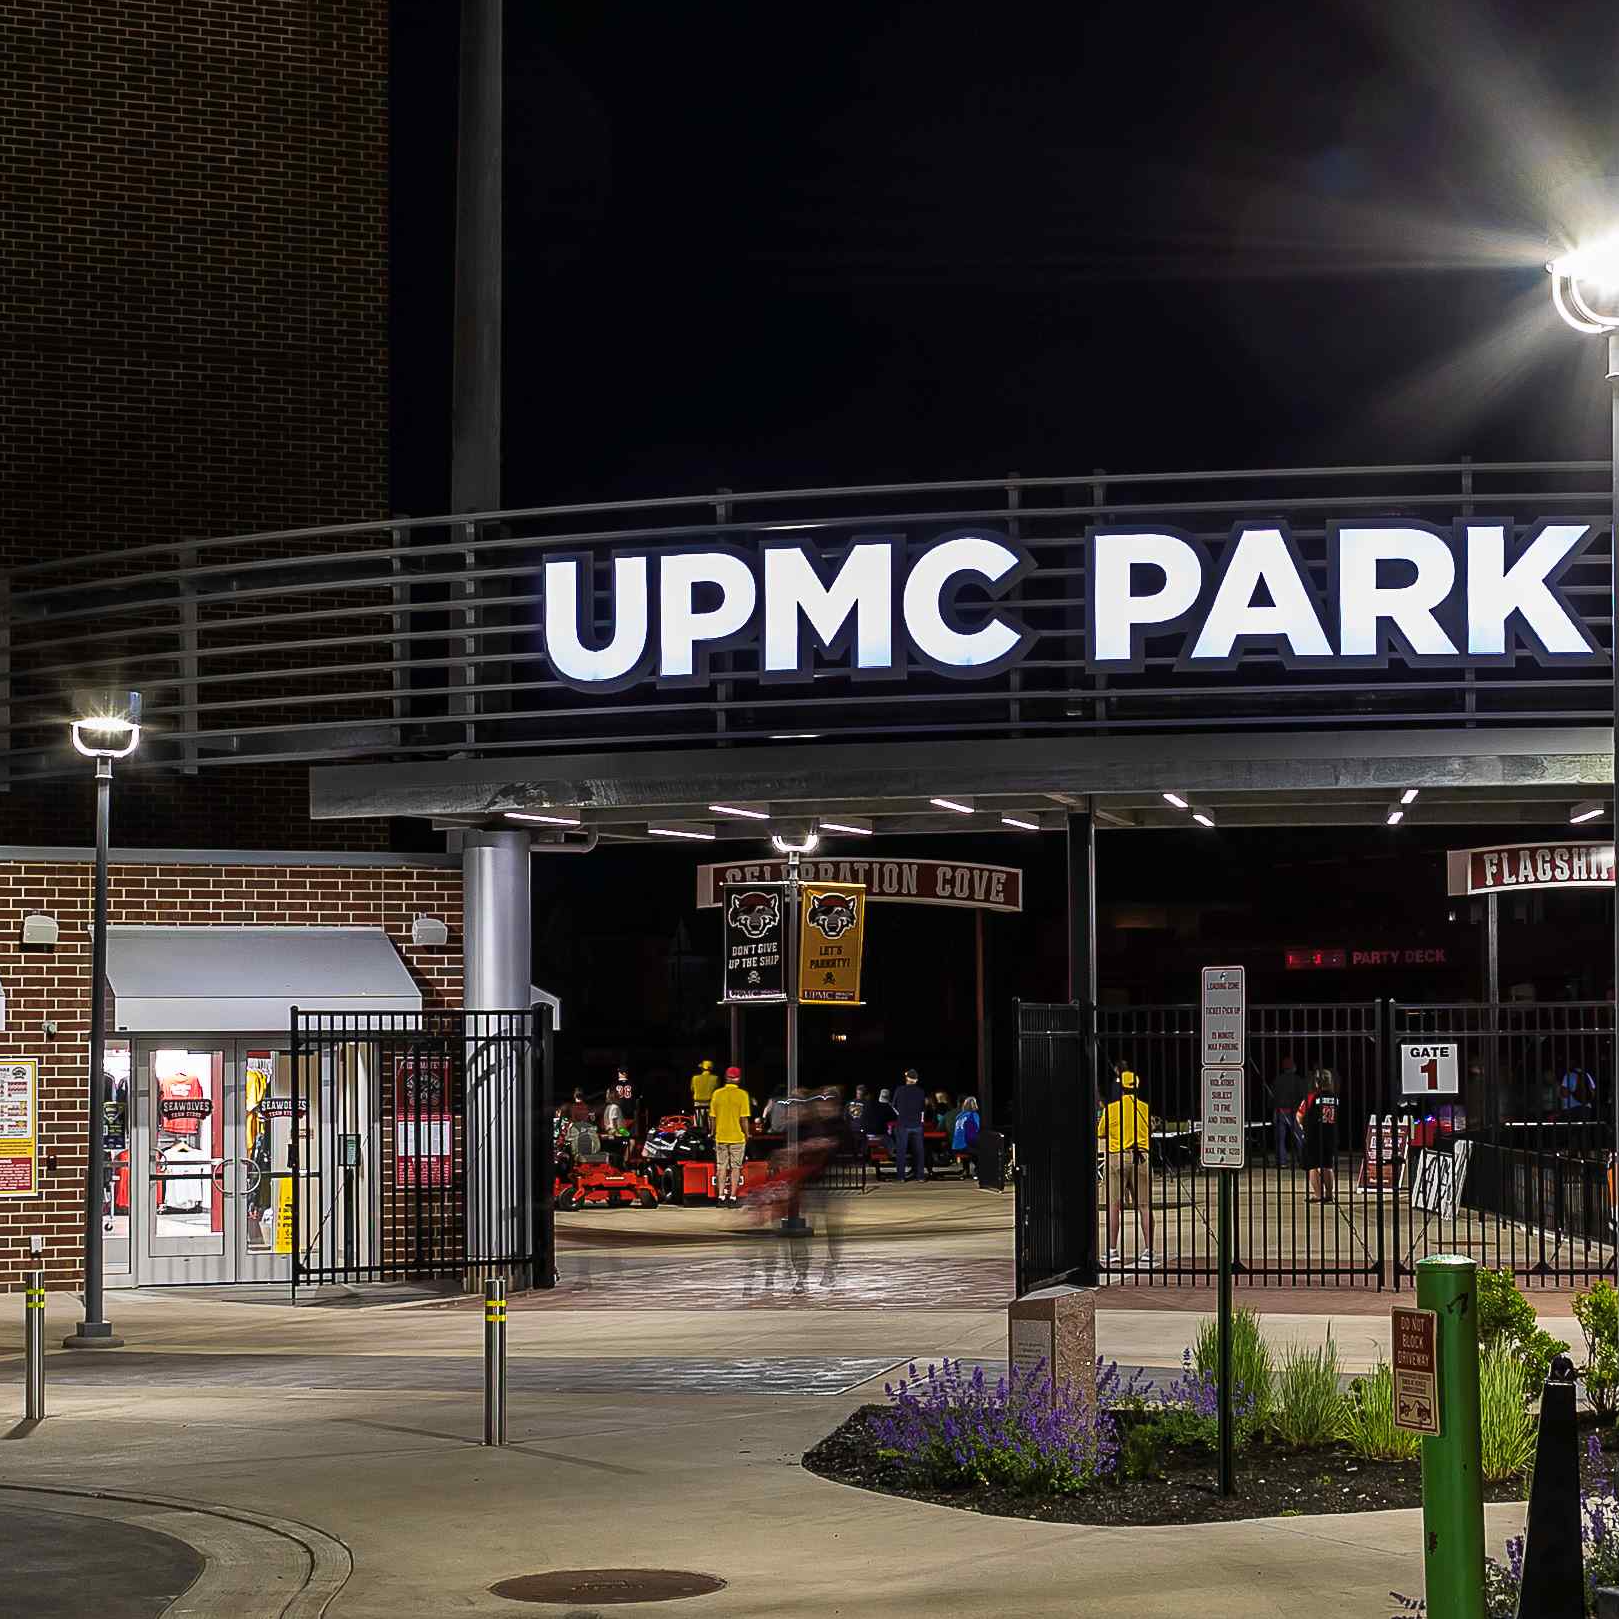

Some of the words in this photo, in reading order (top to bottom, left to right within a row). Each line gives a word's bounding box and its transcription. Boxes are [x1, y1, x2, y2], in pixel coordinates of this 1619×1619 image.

[544, 538, 1021, 680] UPMC
[1093, 525, 1593, 661] PARK
[1484, 847, 1615, 885] FLAGSHIP
[935, 866, 1007, 903] COVE
[732, 944, 756, 956] DON'T
[758, 942, 778, 954] GIVE
[1352, 951, 1399, 964] PARTY
[1404, 949, 1447, 963] DECK
[729, 959, 740, 969] UP
[741, 958, 757, 968] THE
[759, 955, 780, 967] SHIP
[804, 991, 832, 999] UPMC
[1410, 1047, 1449, 1057] GATE
[1420, 1059, 1438, 1090] 1
[163, 1101, 210, 1112] SEAWOLVES
[261, 1100, 307, 1111] SEAWOLES
[1401, 1316, 1411, 1330] DO
[1412, 1317, 1425, 1331] NOT
[1402, 1334, 1424, 1349] BLOCK
[1397, 1350, 1430, 1366] DRIVEWAY
